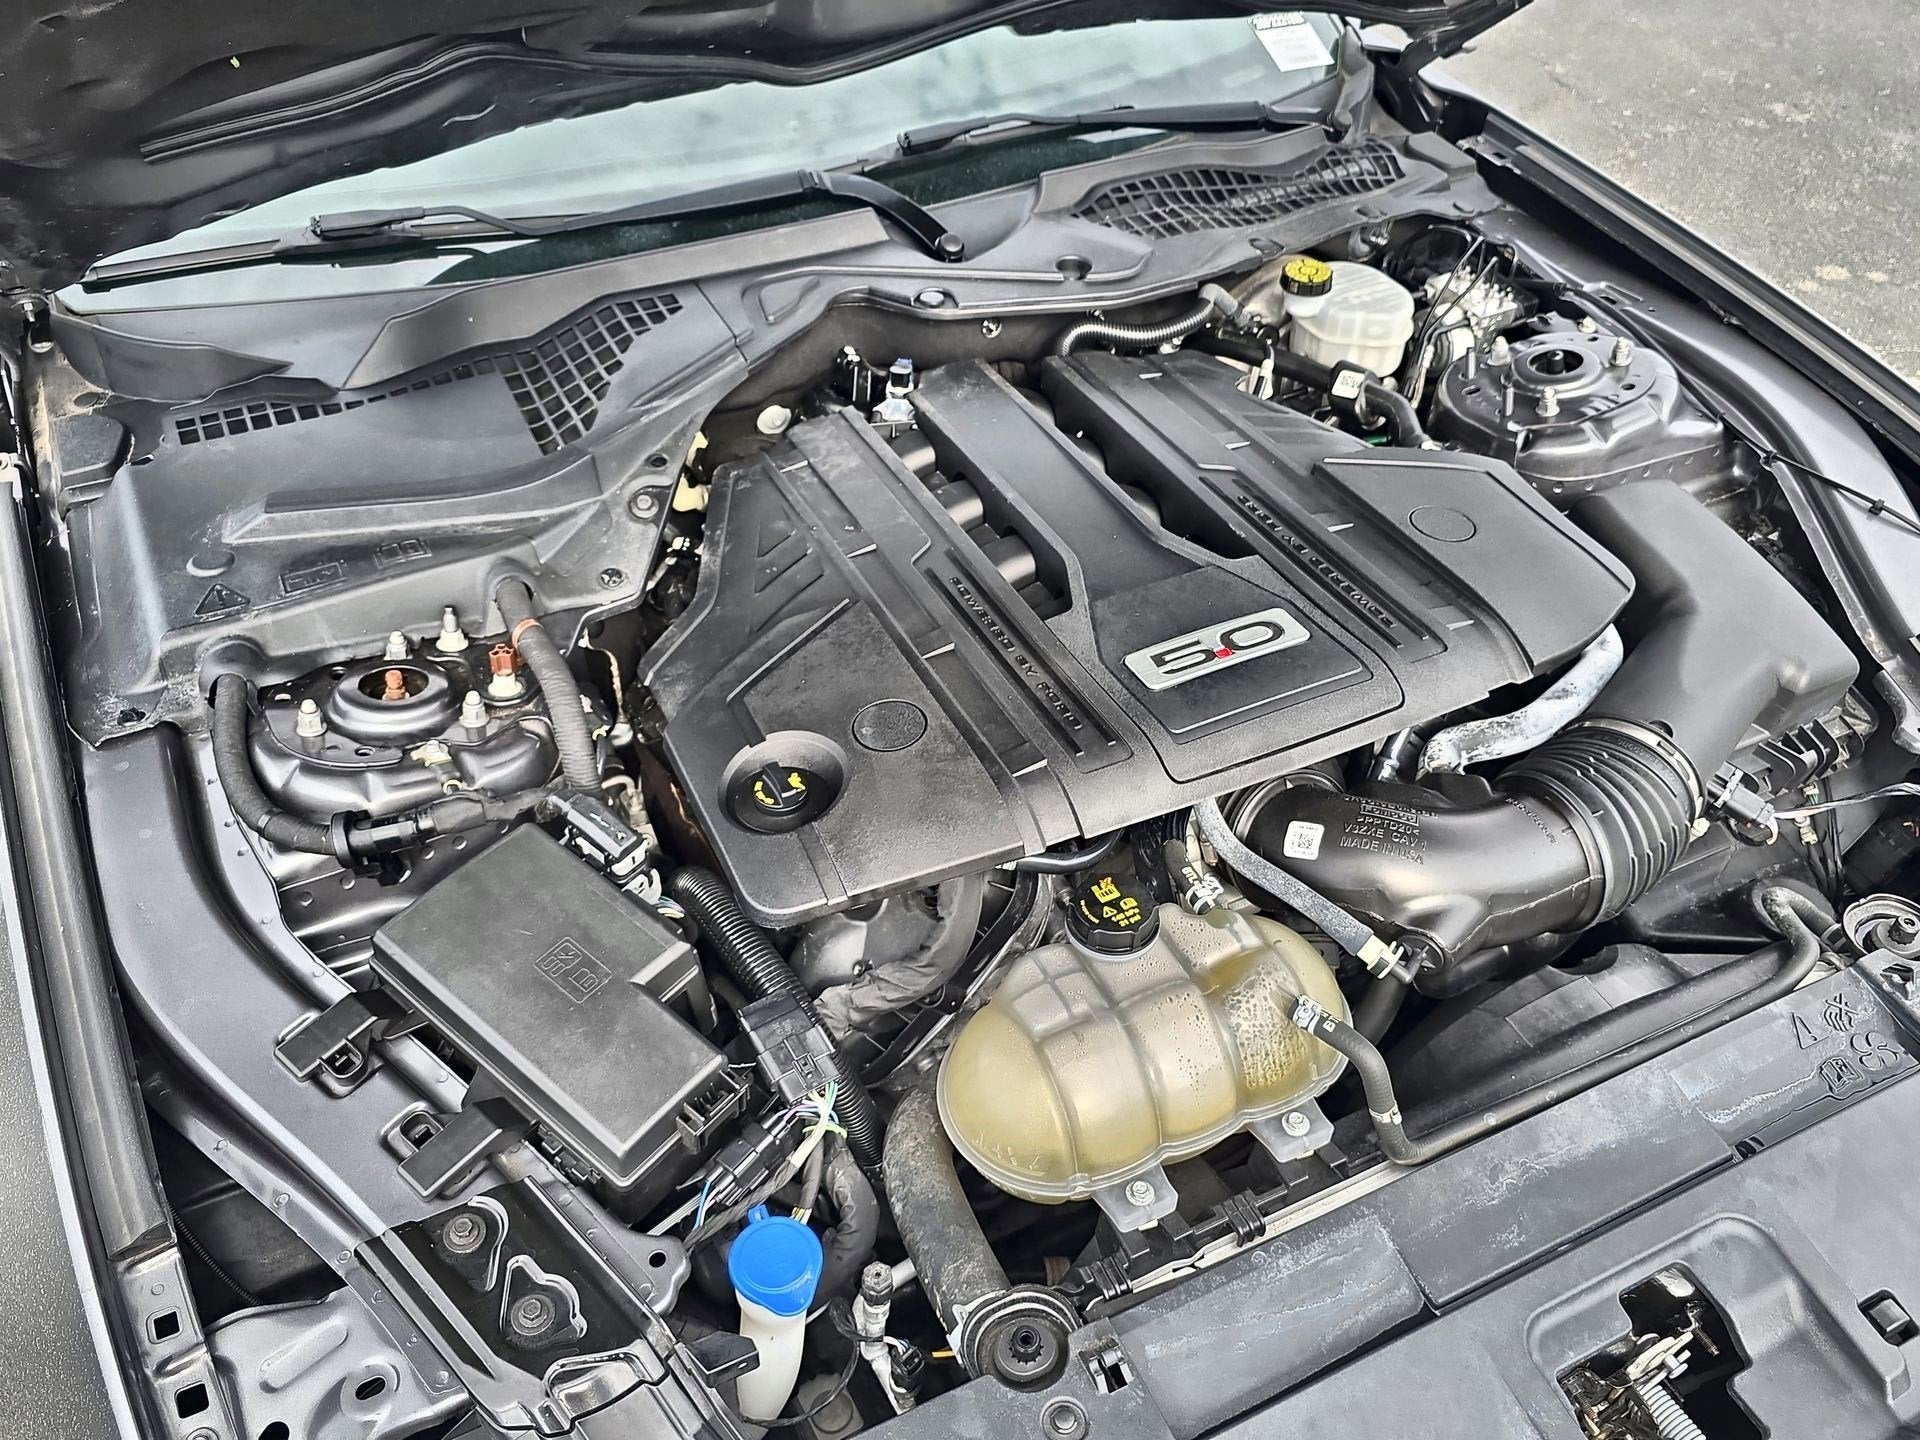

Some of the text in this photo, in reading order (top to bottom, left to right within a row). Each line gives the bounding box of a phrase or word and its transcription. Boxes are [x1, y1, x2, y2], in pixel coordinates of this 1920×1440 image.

[949, 576, 1083, 731] POWERED BY FORD
[1150, 620, 1286, 675] 5.0
[1340, 835, 1425, 865] MADE IN USA
[1391, 832, 1419, 848] CAV
